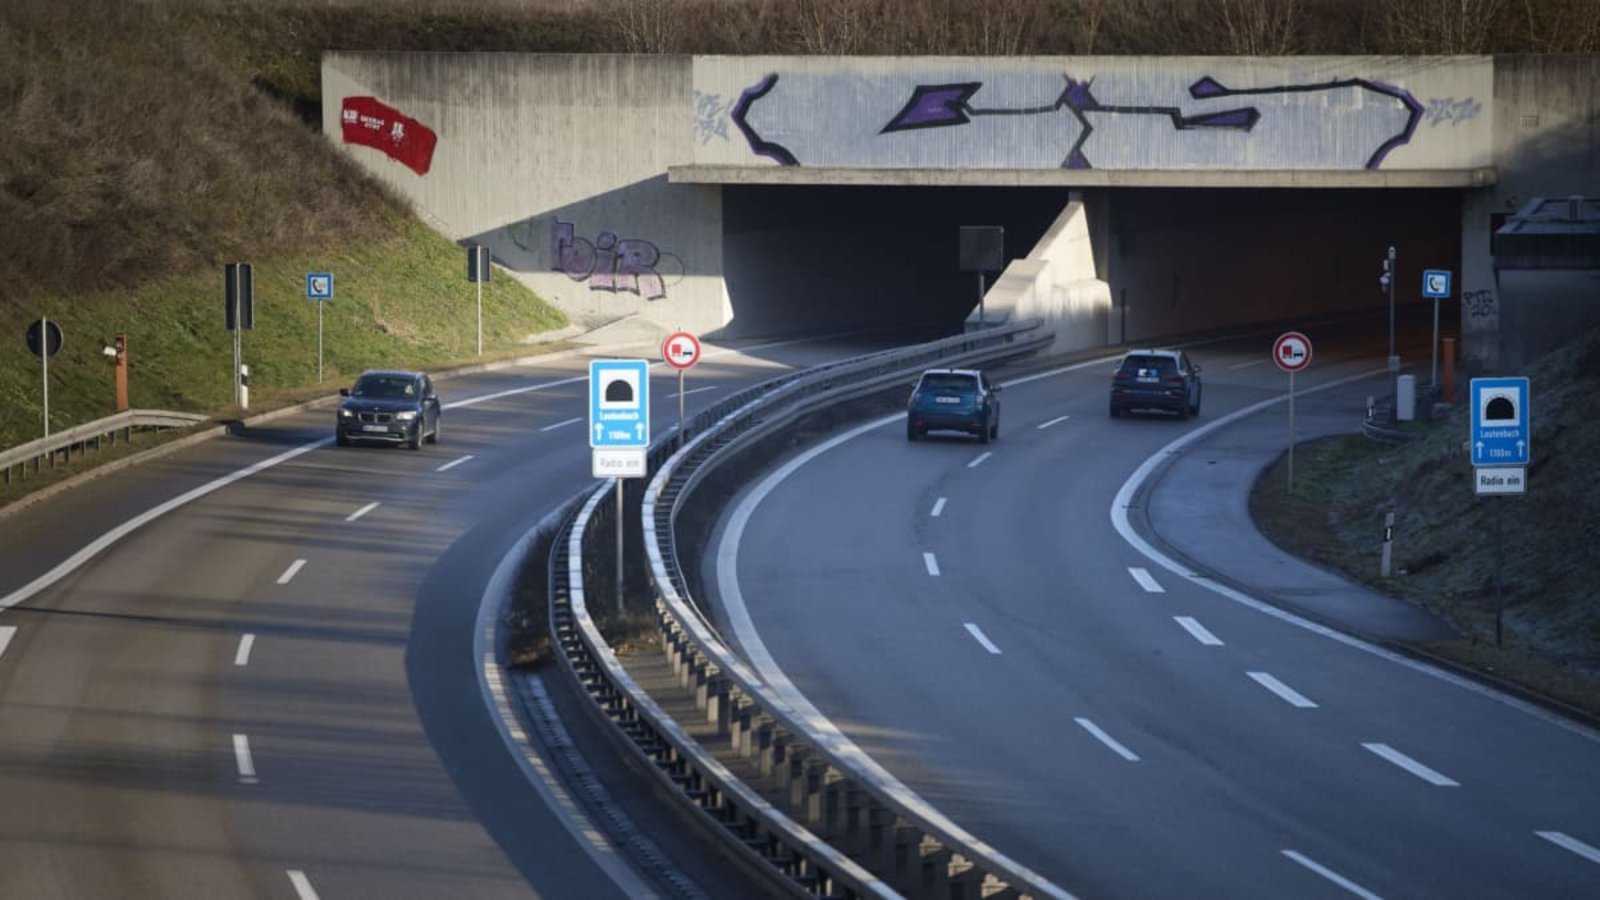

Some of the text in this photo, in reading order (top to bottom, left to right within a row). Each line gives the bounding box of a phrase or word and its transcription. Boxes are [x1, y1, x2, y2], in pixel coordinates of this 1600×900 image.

[600, 410, 640, 421] Lautenbach
[1480, 428, 1520, 439] Lautenbach
[1489, 447, 1512, 458] 1100m
[600, 457, 640, 468] Radio ein
[1480, 475, 1521, 486] Radio ein
